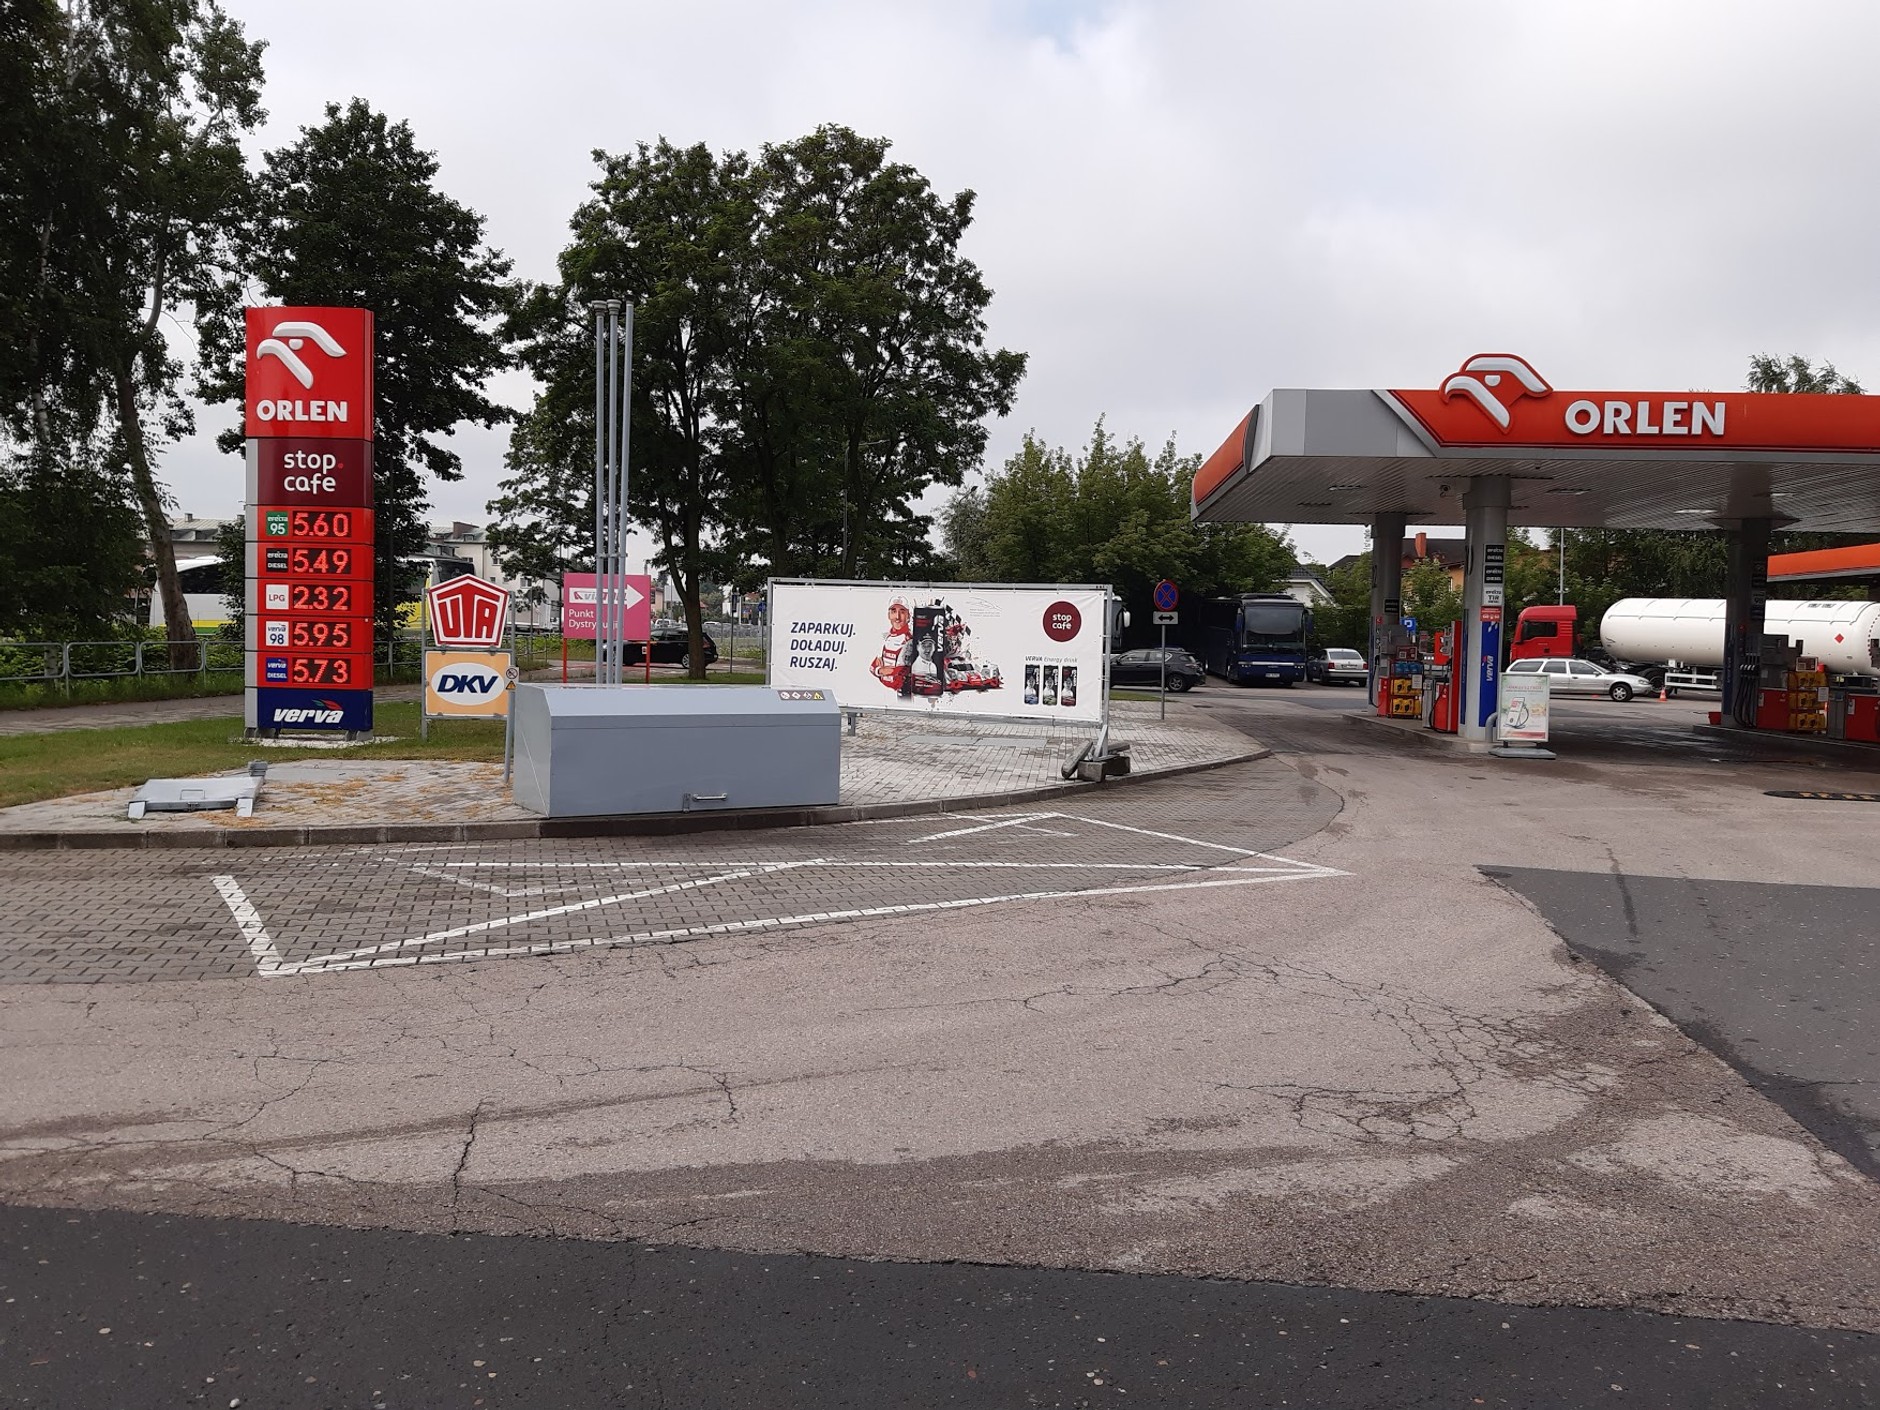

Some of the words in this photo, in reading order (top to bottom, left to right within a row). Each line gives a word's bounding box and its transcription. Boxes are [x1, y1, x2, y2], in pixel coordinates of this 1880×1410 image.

[256, 400, 348, 422] ORLEN
[1564, 399, 1726, 436] ORLEN
[284, 474, 336, 494] cafe
[270, 523, 286, 535] 95
[294, 512, 349, 537] 5.60
[294, 549, 349, 574] 5.49
[268, 594, 285, 602] LPG
[293, 586, 349, 611] 2.32
[436, 582, 500, 639] UTA
[568, 609, 594, 618] Punkt
[293, 622, 349, 647] 5.95
[790, 622, 857, 638] ZAPARKUJ.
[1052, 622, 1072, 630] cafe
[269, 634, 284, 644] 98
[790, 639, 848, 655] DOŁADUJ.
[293, 659, 348, 683] 5.73
[789, 656, 839, 672] RUSZAJ.
[437, 674, 499, 694] DKV
[273, 707, 344, 724] verva
